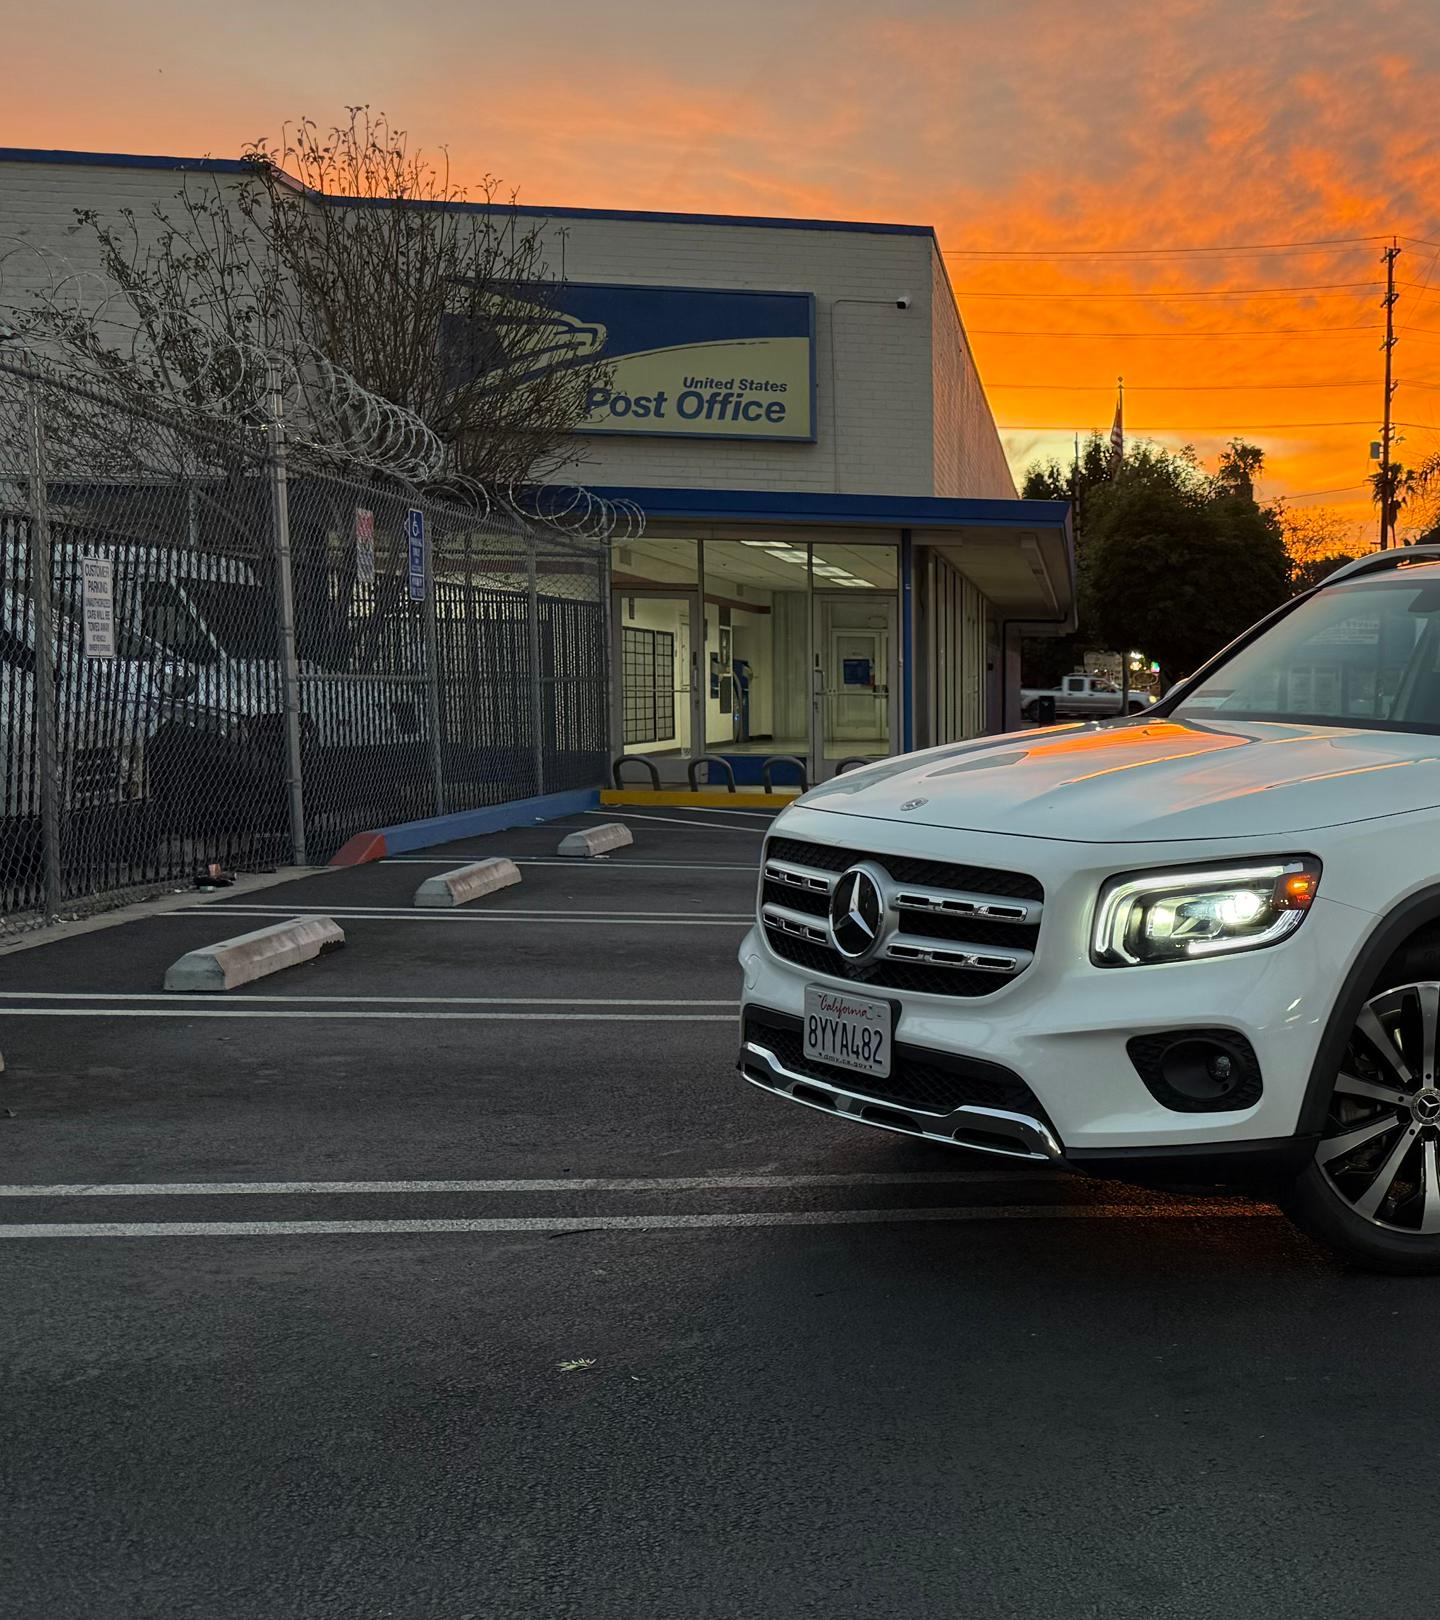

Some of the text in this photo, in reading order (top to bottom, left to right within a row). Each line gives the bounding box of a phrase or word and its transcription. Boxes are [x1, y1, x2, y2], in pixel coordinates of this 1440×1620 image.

[683, 377, 788, 392] United States
[585, 388, 786, 423] Post Office
[85, 563, 110, 578] CUSTOMER
[88, 580, 108, 593] PARKING
[820, 994, 873, 1020] California
[809, 1015, 883, 1065] 8YYA482
